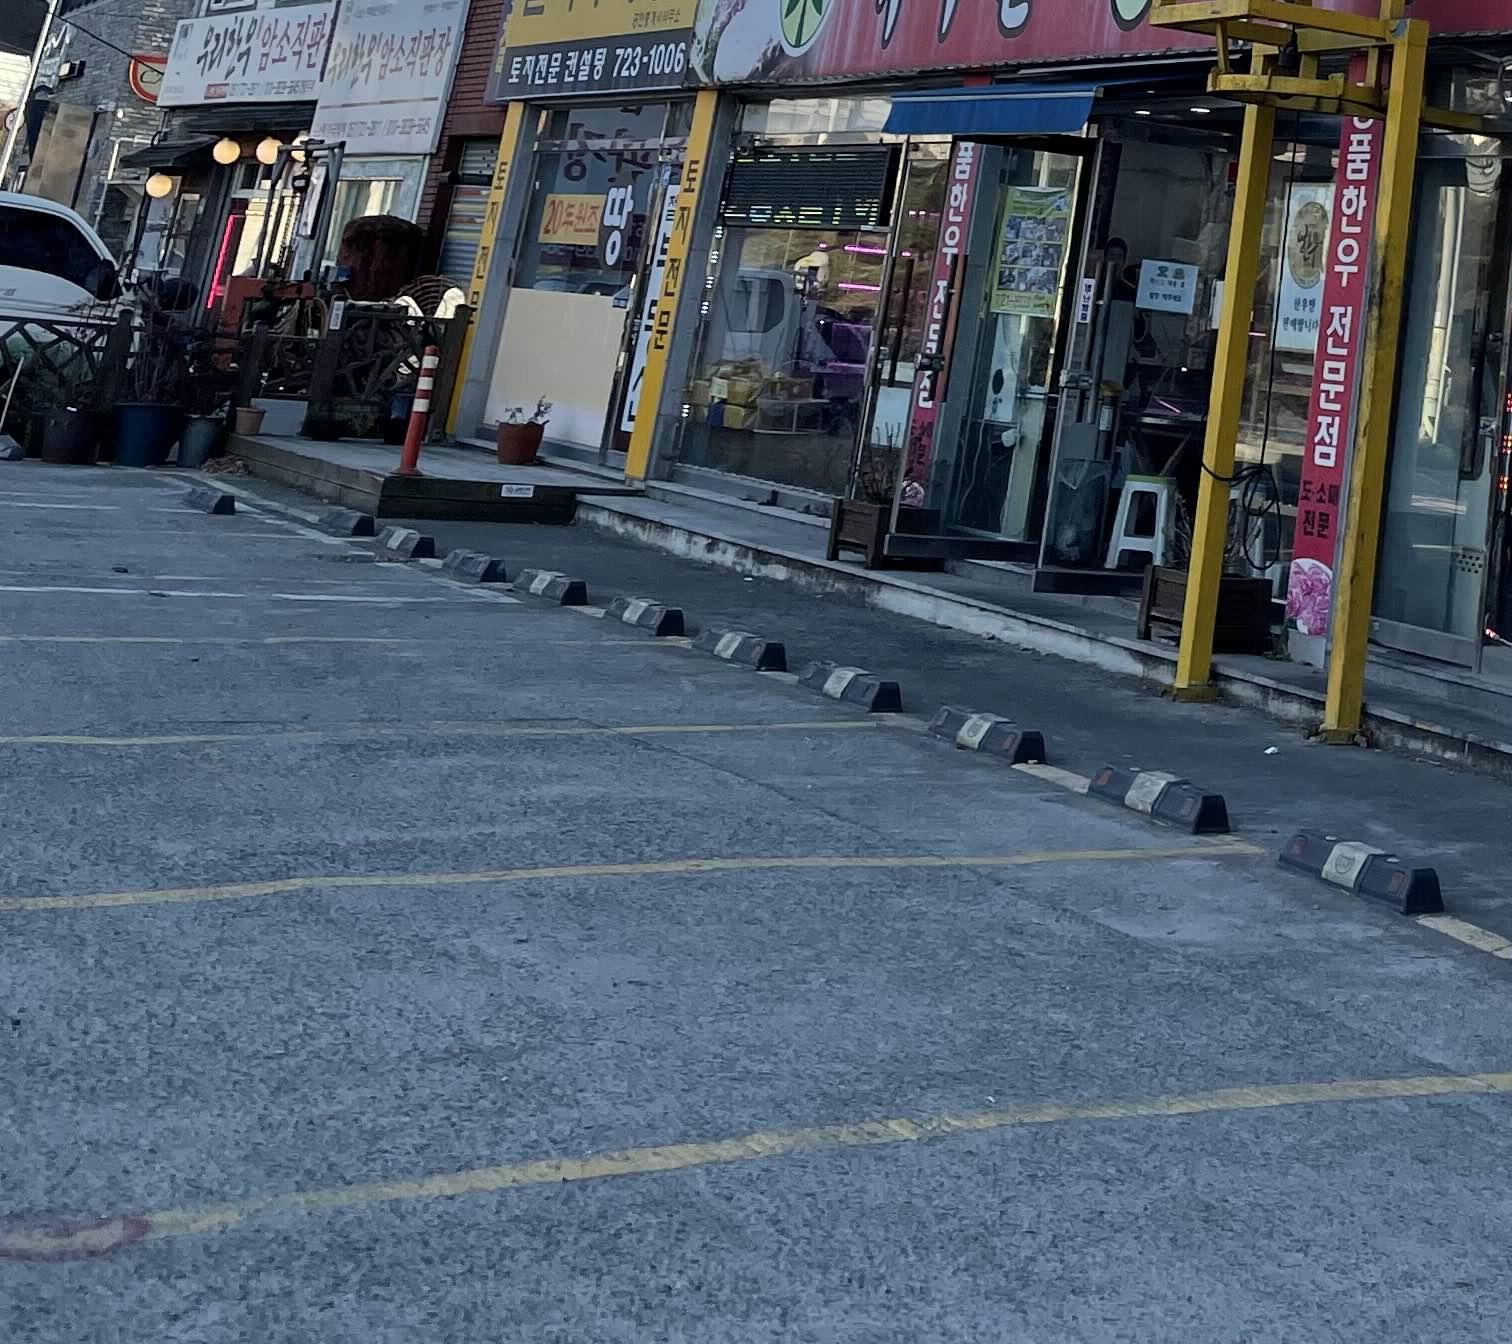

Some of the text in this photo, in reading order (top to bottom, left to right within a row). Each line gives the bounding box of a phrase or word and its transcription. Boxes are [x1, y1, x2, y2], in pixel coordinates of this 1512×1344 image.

[258, 13, 331, 74] 암소직판
[613, 41, 687, 78] 723-1006
[603, 184, 634, 266] 땅
[1313, 306, 1353, 469] 전문점
